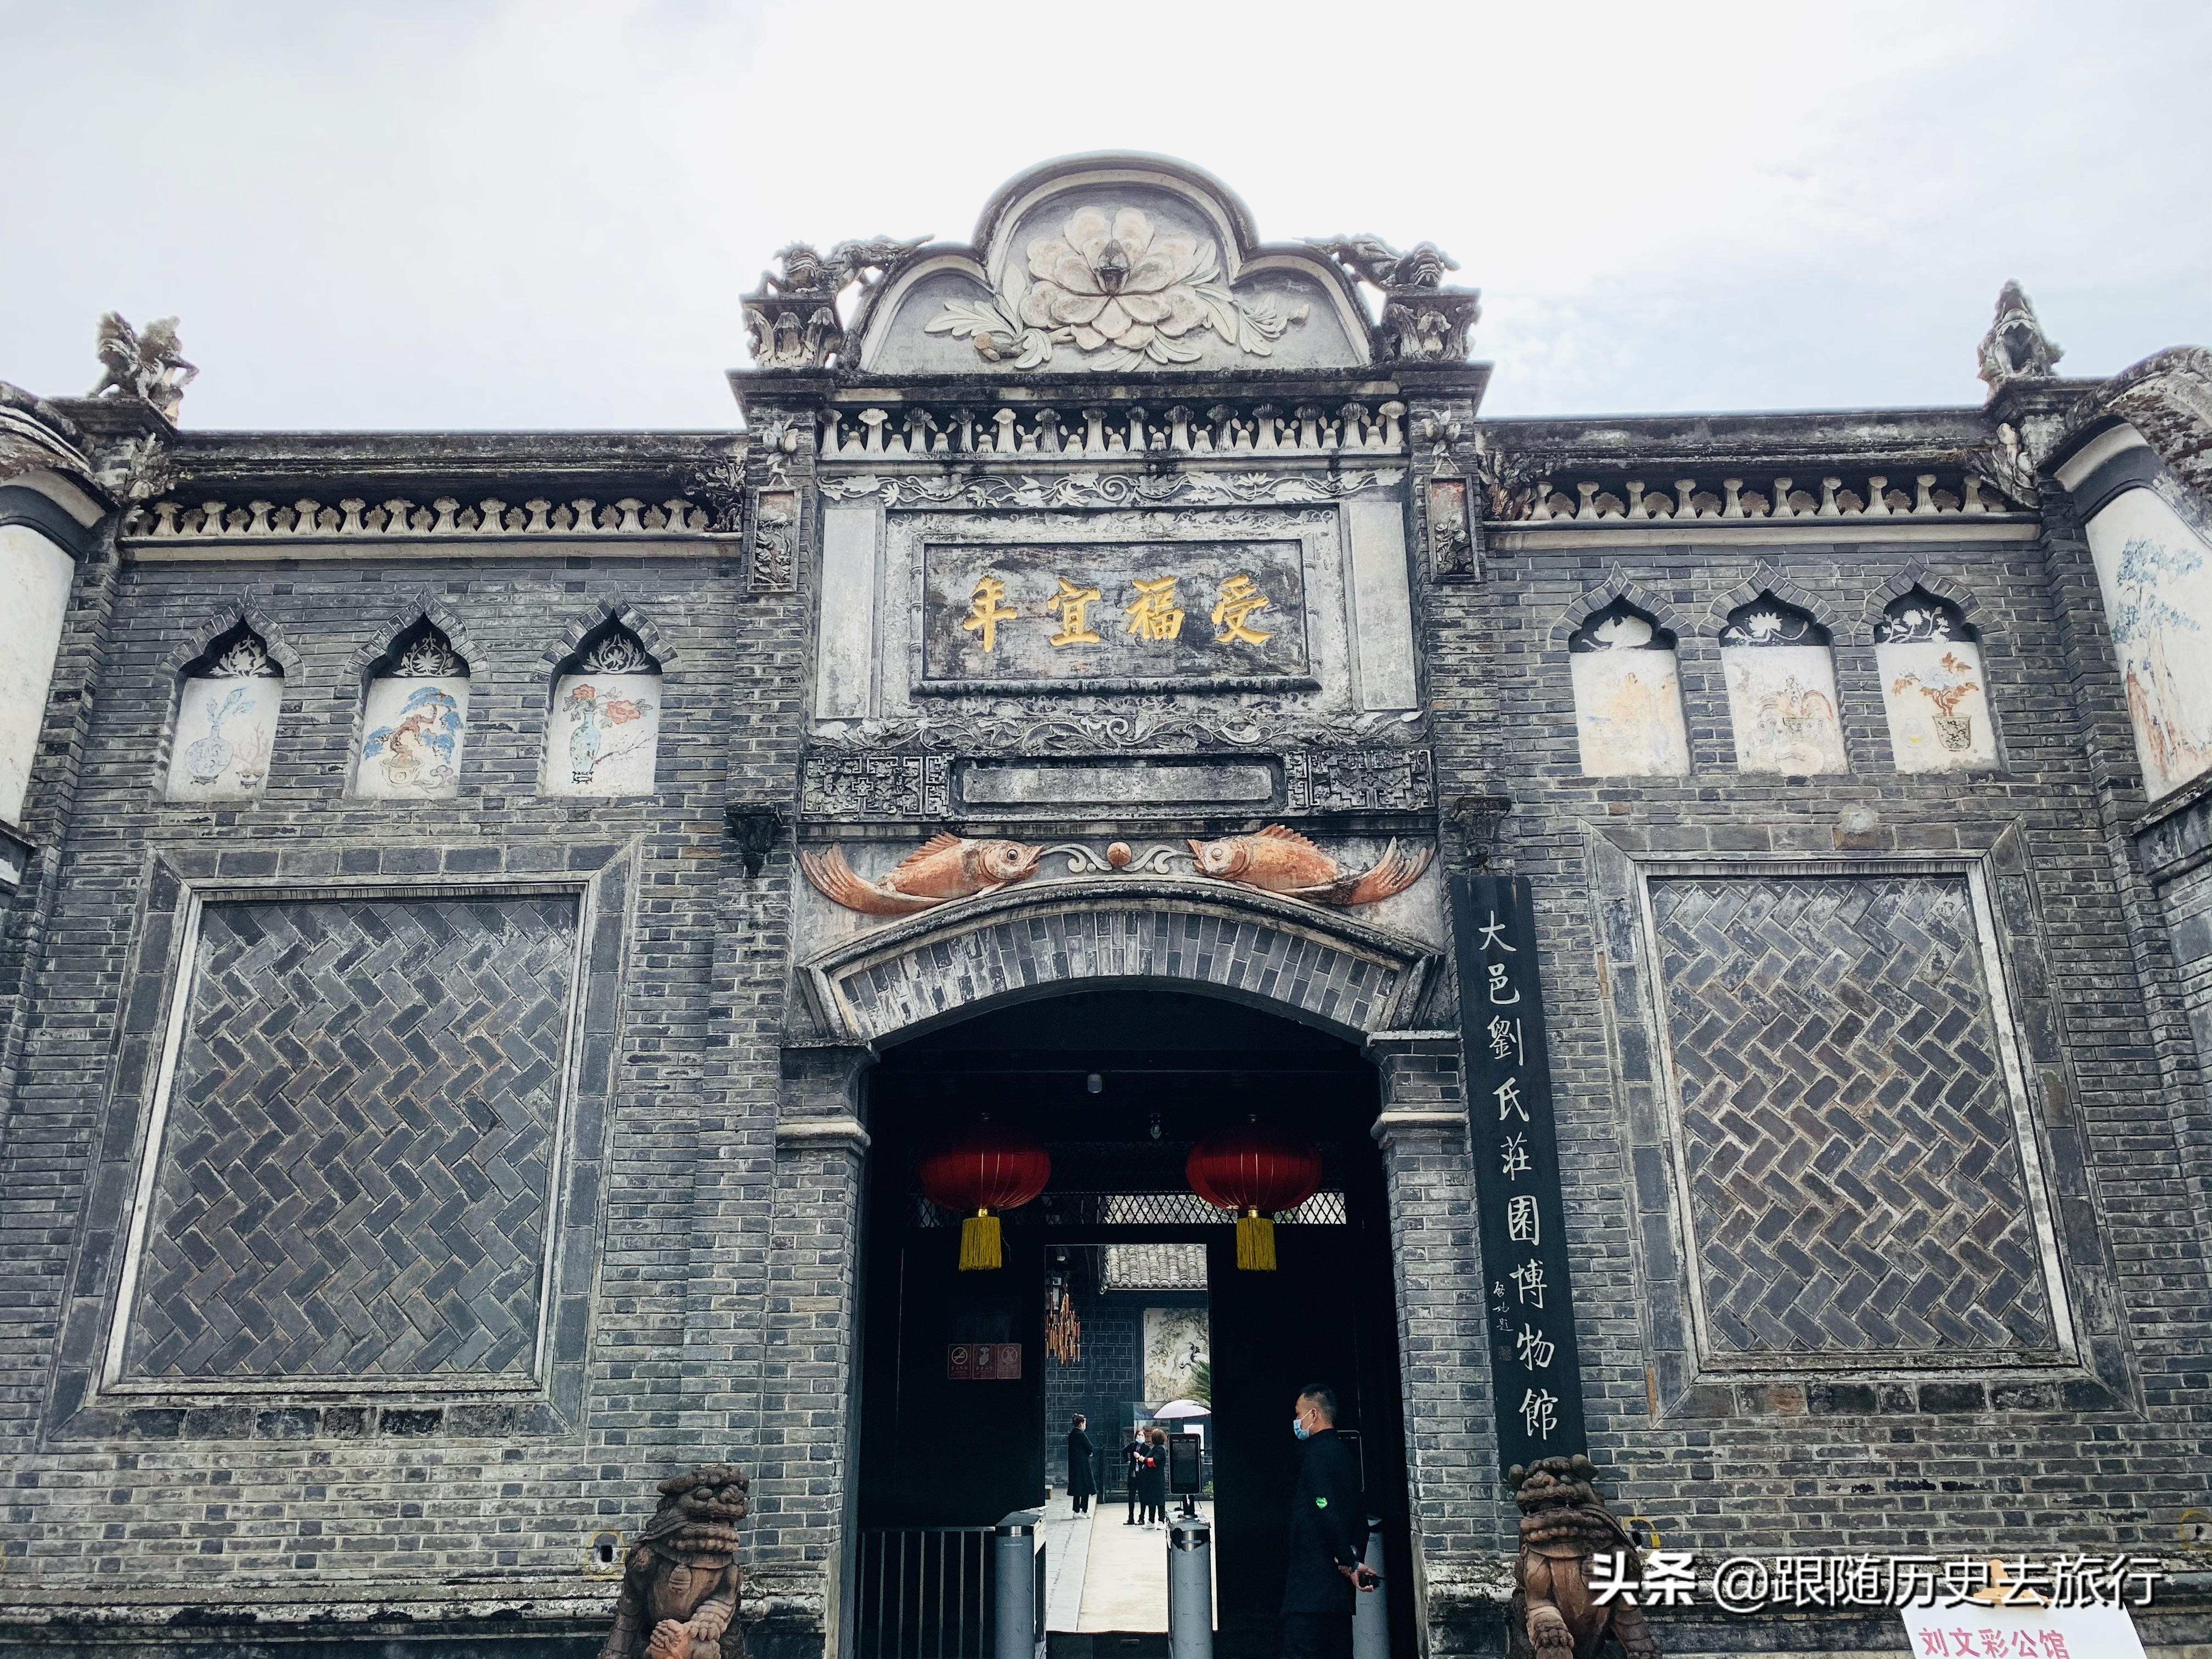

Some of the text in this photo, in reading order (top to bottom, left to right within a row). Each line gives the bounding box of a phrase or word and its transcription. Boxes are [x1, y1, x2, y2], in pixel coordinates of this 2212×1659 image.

[1918, 1627, 2070, 1659] 刘文彩公馆
